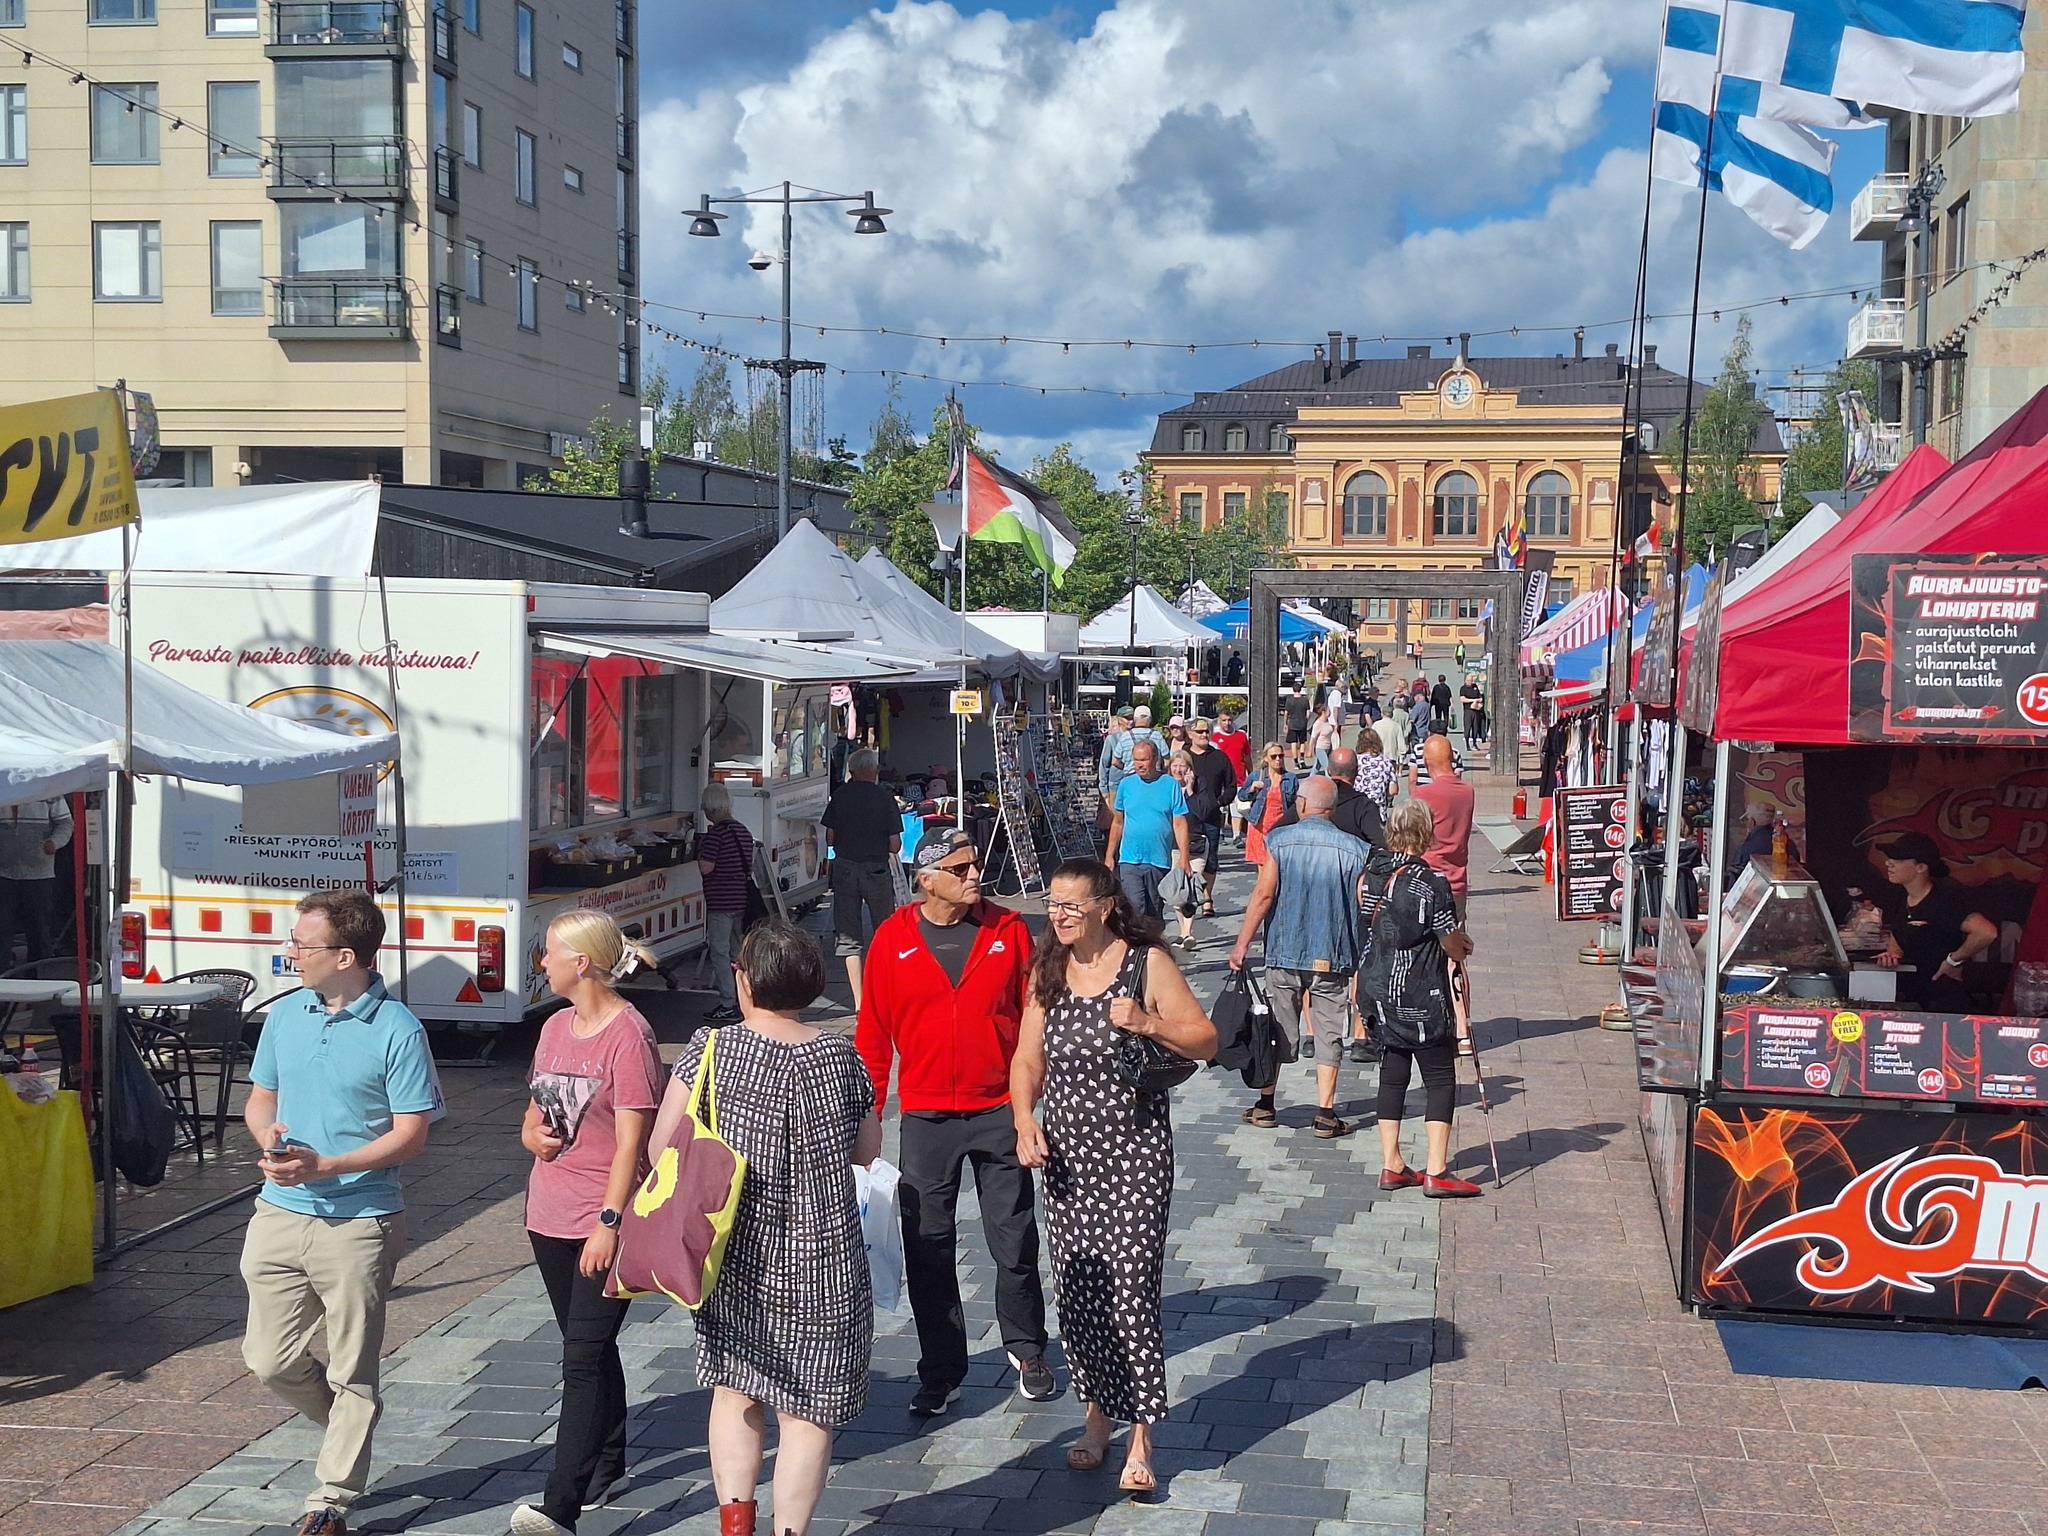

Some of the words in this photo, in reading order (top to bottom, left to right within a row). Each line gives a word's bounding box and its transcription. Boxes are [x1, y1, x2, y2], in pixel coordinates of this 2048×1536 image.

[1907, 575, 2048, 596] AURAJUUSTO-
[1920, 599, 2037, 620] LOHIATERIA
[1915, 623, 2018, 642] aurajuustolohi
[148, 638, 234, 663] Parasta
[236, 646, 353, 668] paikallista
[1915, 641, 1976, 659] paistetut
[1979, 641, 2036, 660] perunat
[1914, 655, 1997, 671] vihannekset
[1914, 672, 1952, 687] talon
[1955, 672, 2003, 687] kastike
[343, 772, 373, 800] OMENA
[342, 805, 376, 837] LÖRTSYT
[229, 835, 282, 847] RIESKAT
[355, 841, 398, 850] KKOT
[259, 849, 311, 860] MUNKIT
